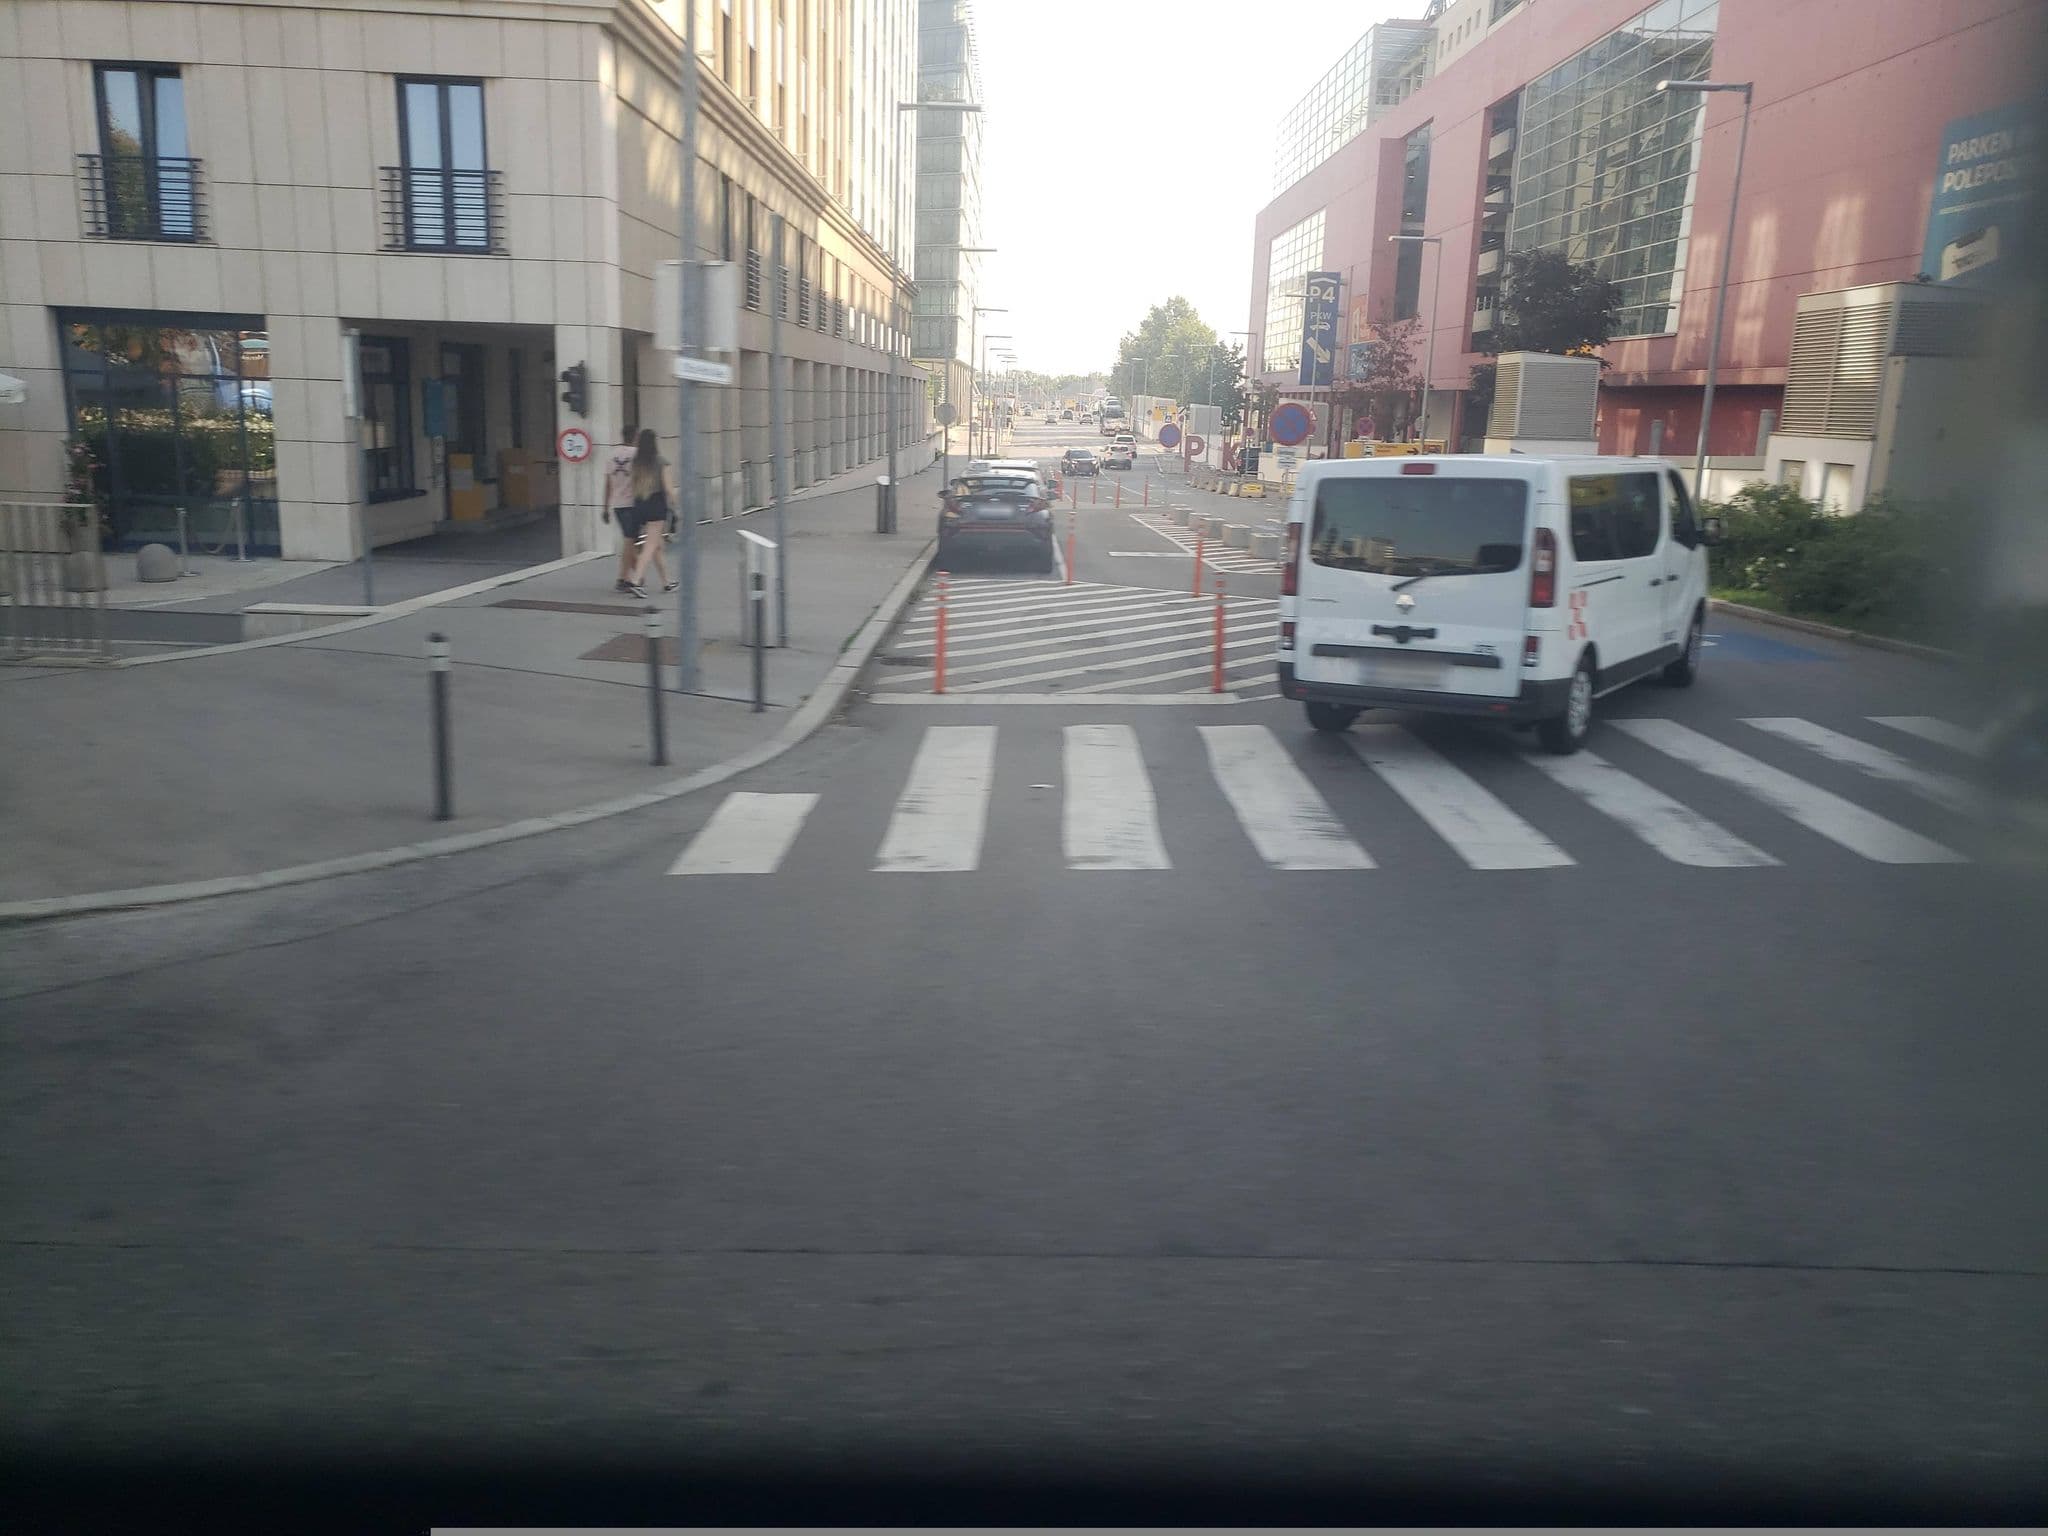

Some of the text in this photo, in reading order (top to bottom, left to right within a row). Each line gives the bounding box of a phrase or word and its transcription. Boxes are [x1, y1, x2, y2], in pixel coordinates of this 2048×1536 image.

[1310, 286, 1335, 303] P4
[1310, 311, 1331, 320] PKW
[1184, 434, 1205, 472] P
